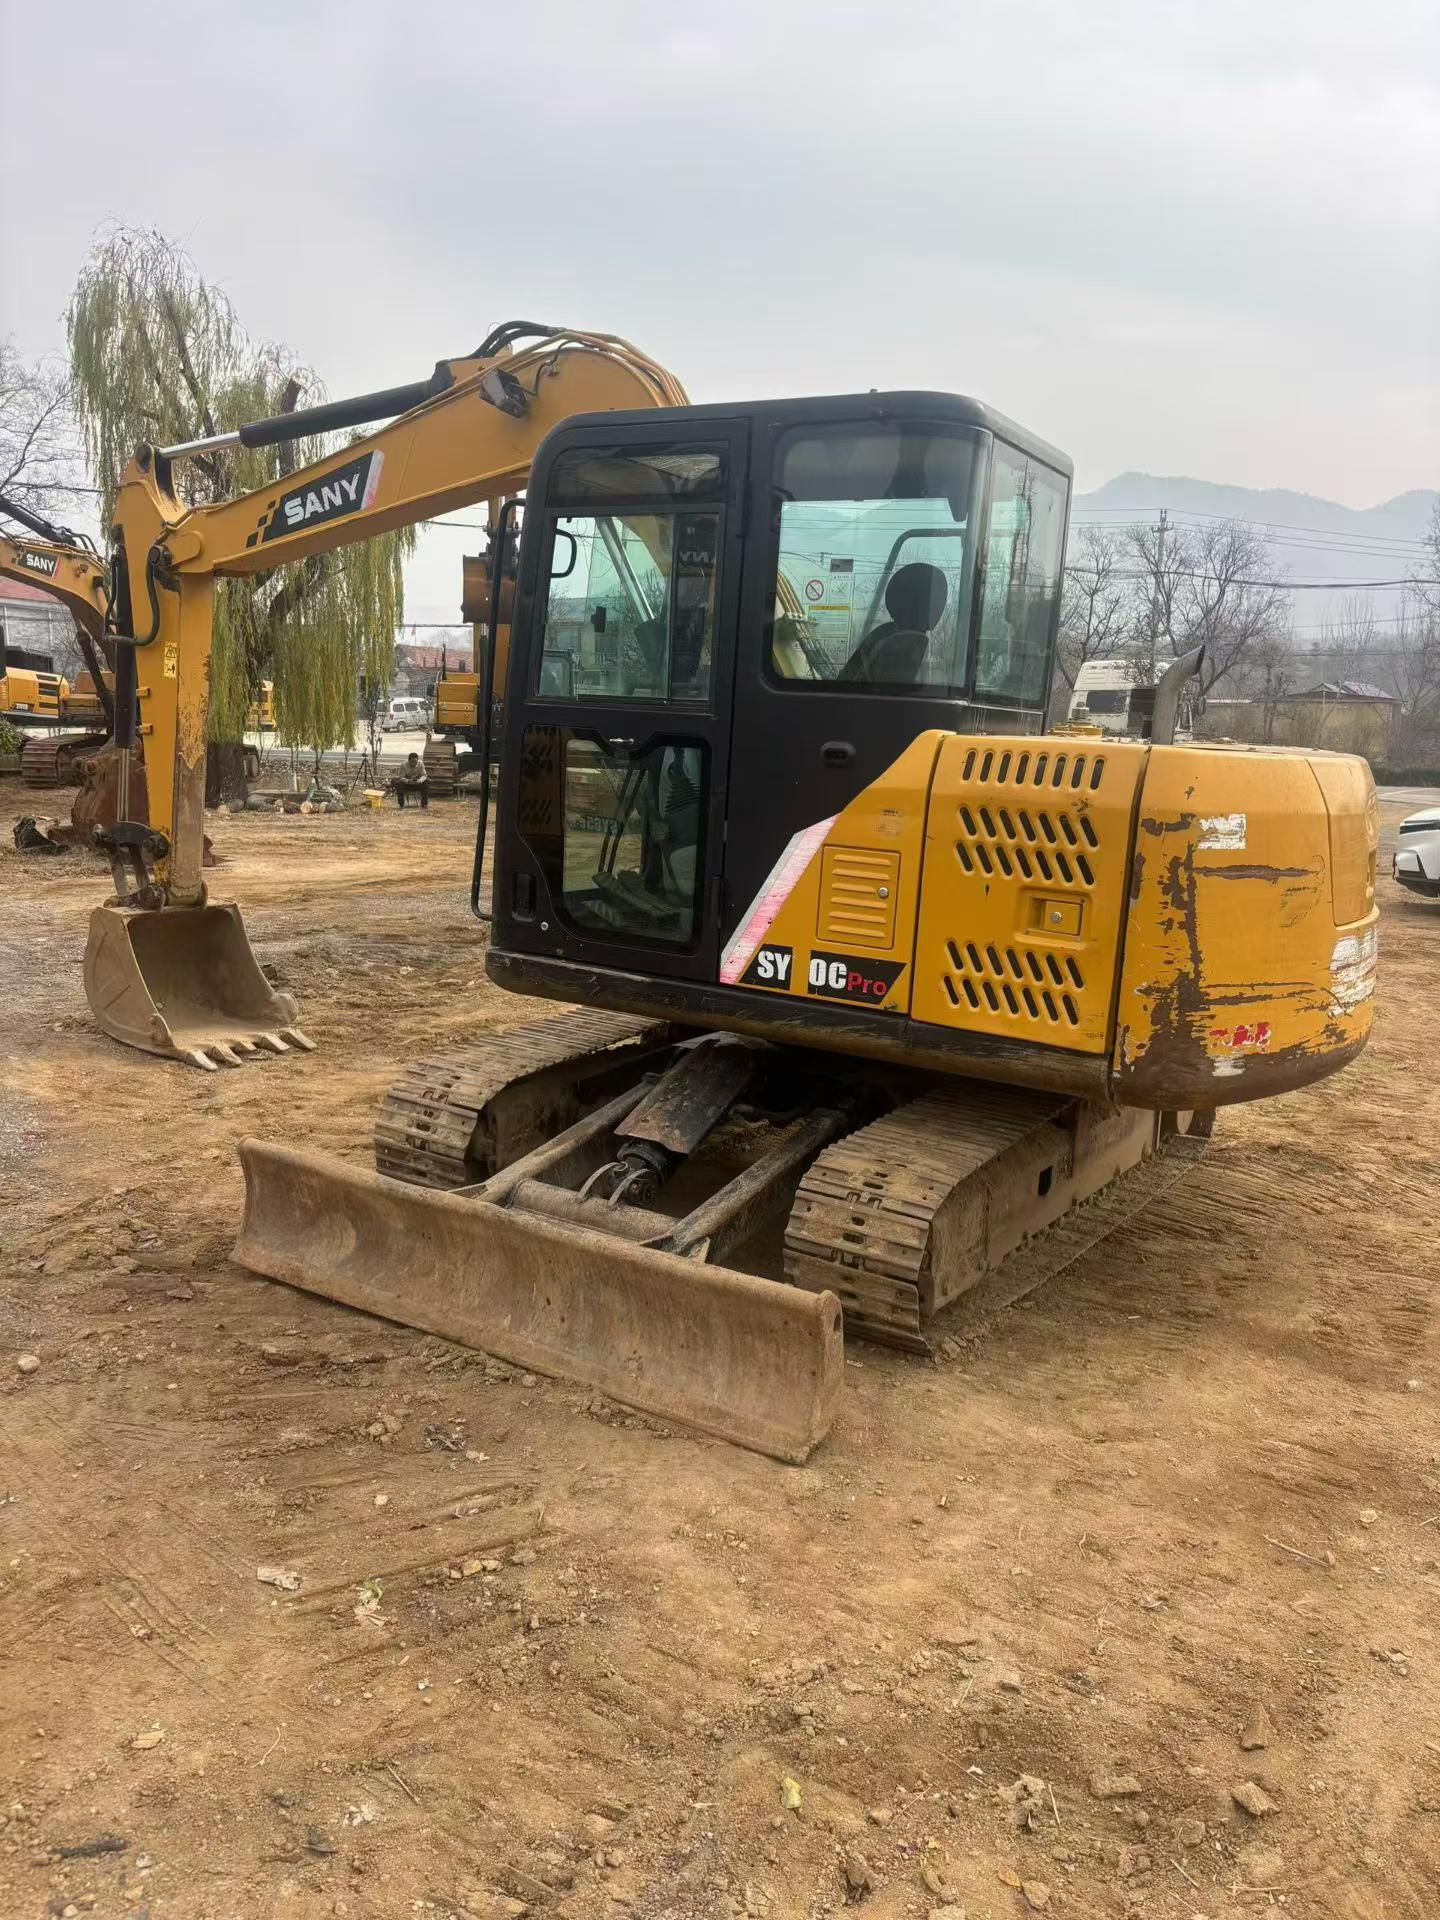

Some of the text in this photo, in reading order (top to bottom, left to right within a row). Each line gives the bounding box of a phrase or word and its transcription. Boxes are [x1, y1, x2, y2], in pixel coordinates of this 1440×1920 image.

[284, 472, 361, 526] SANY
[26, 553, 55, 572] SANY
[757, 950, 792, 981] SY
